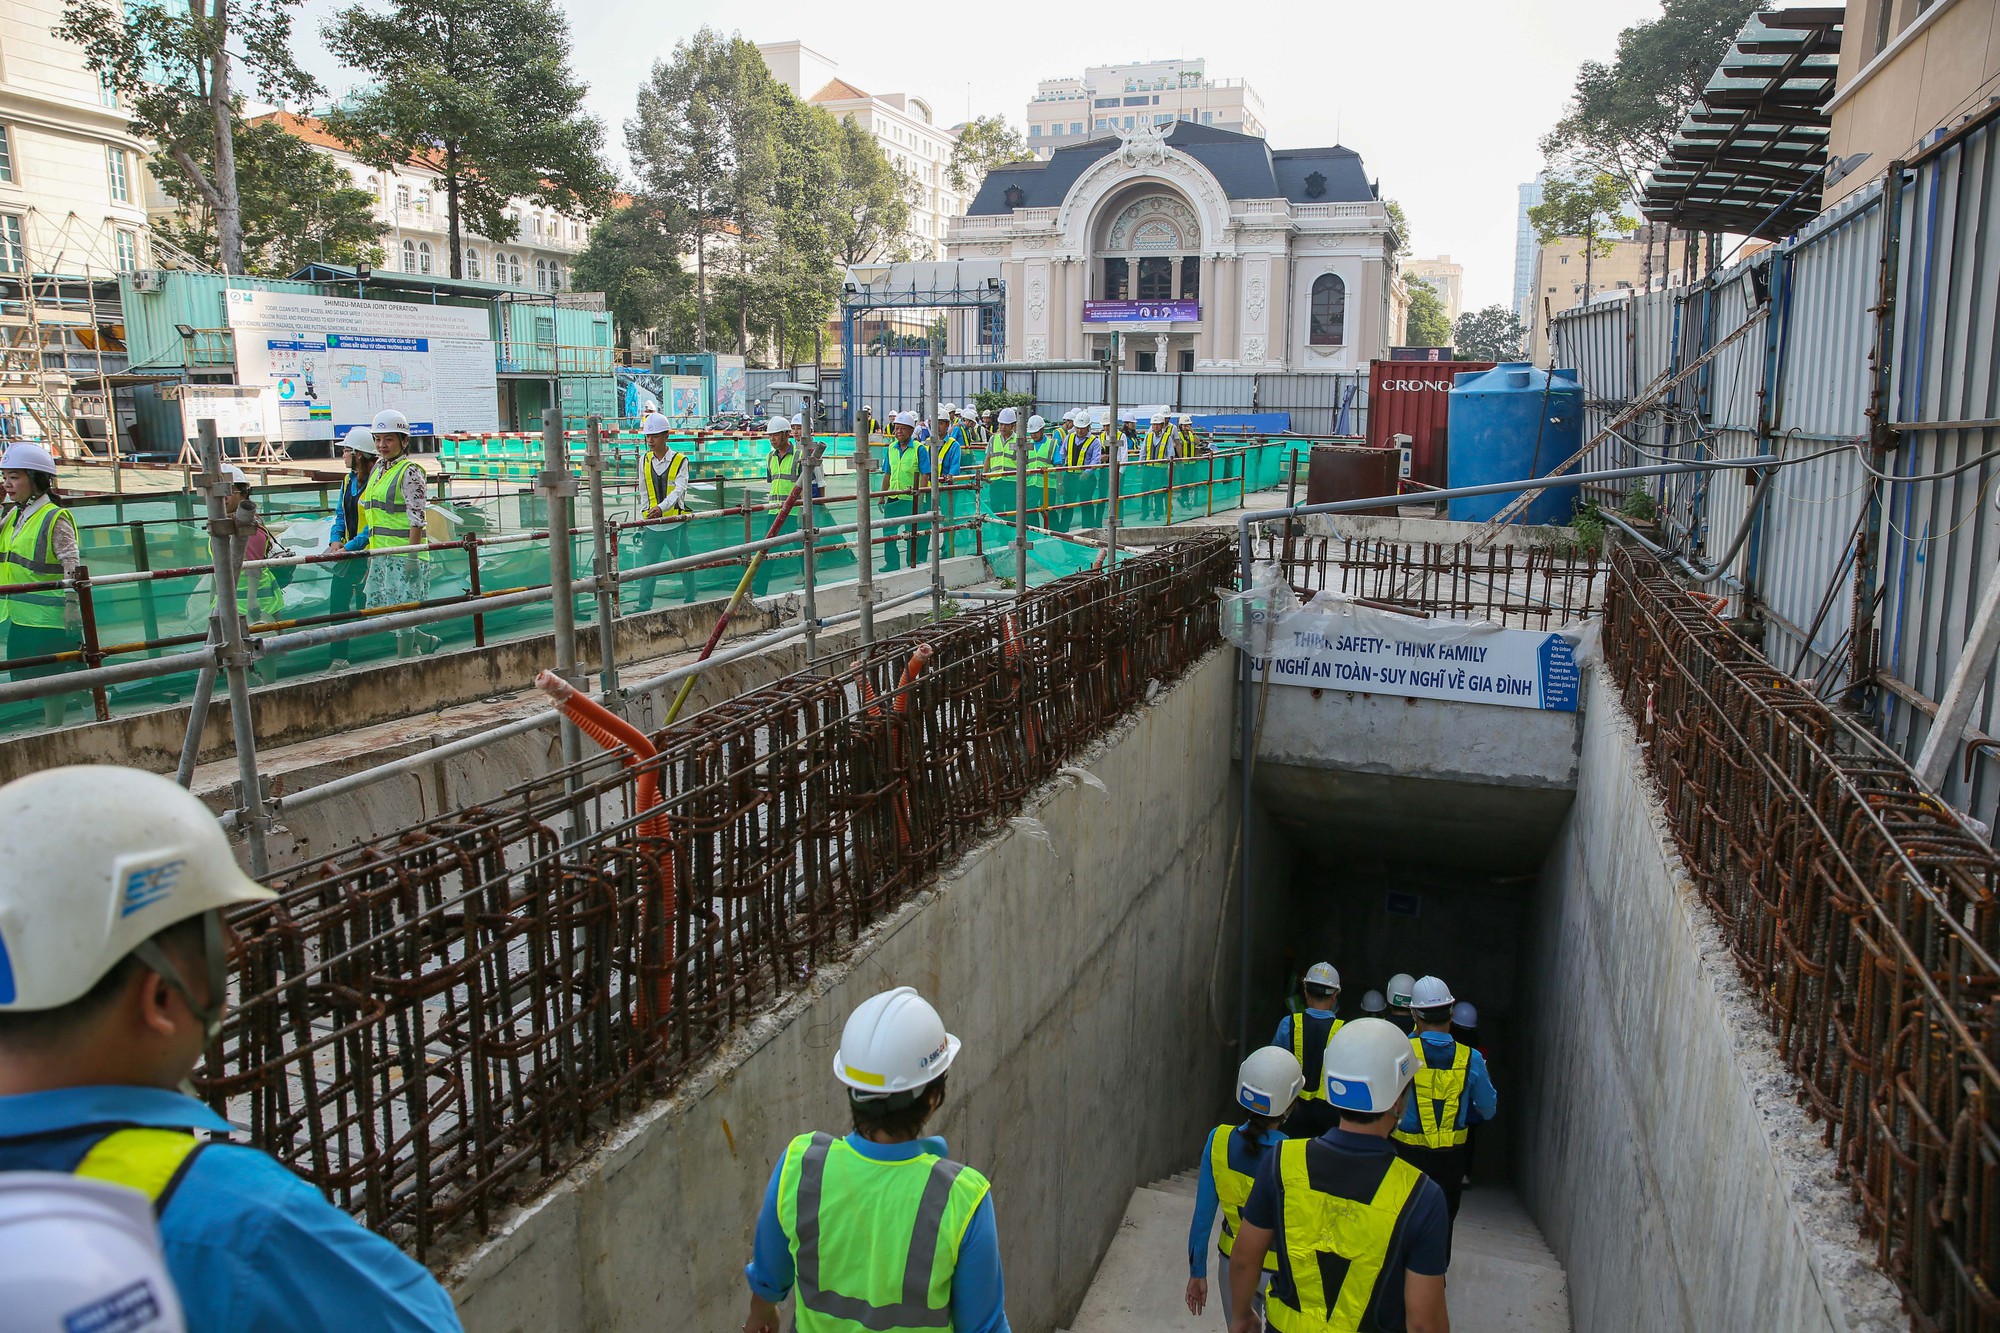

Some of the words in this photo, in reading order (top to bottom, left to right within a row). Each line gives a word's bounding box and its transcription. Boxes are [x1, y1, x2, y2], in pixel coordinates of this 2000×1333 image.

[323, 300, 371, 308] SHIMIZU-MAEDA
[372, 302, 388, 310] JOINT
[389, 304, 418, 312] OPERATION
[1382, 380, 1455, 392] CRONO
[1394, 641, 1436, 659] THINK
[1439, 644, 1488, 662] FAMILY
[1276, 657, 1310, 676] NGHĨ
[1312, 662, 1331, 678] AN
[1409, 668, 1446, 688] NGHĨ
[1448, 667, 1465, 690] VỀ
[1468, 675, 1492, 692] GIA
[1496, 674, 1532, 696] ĐÌNH
